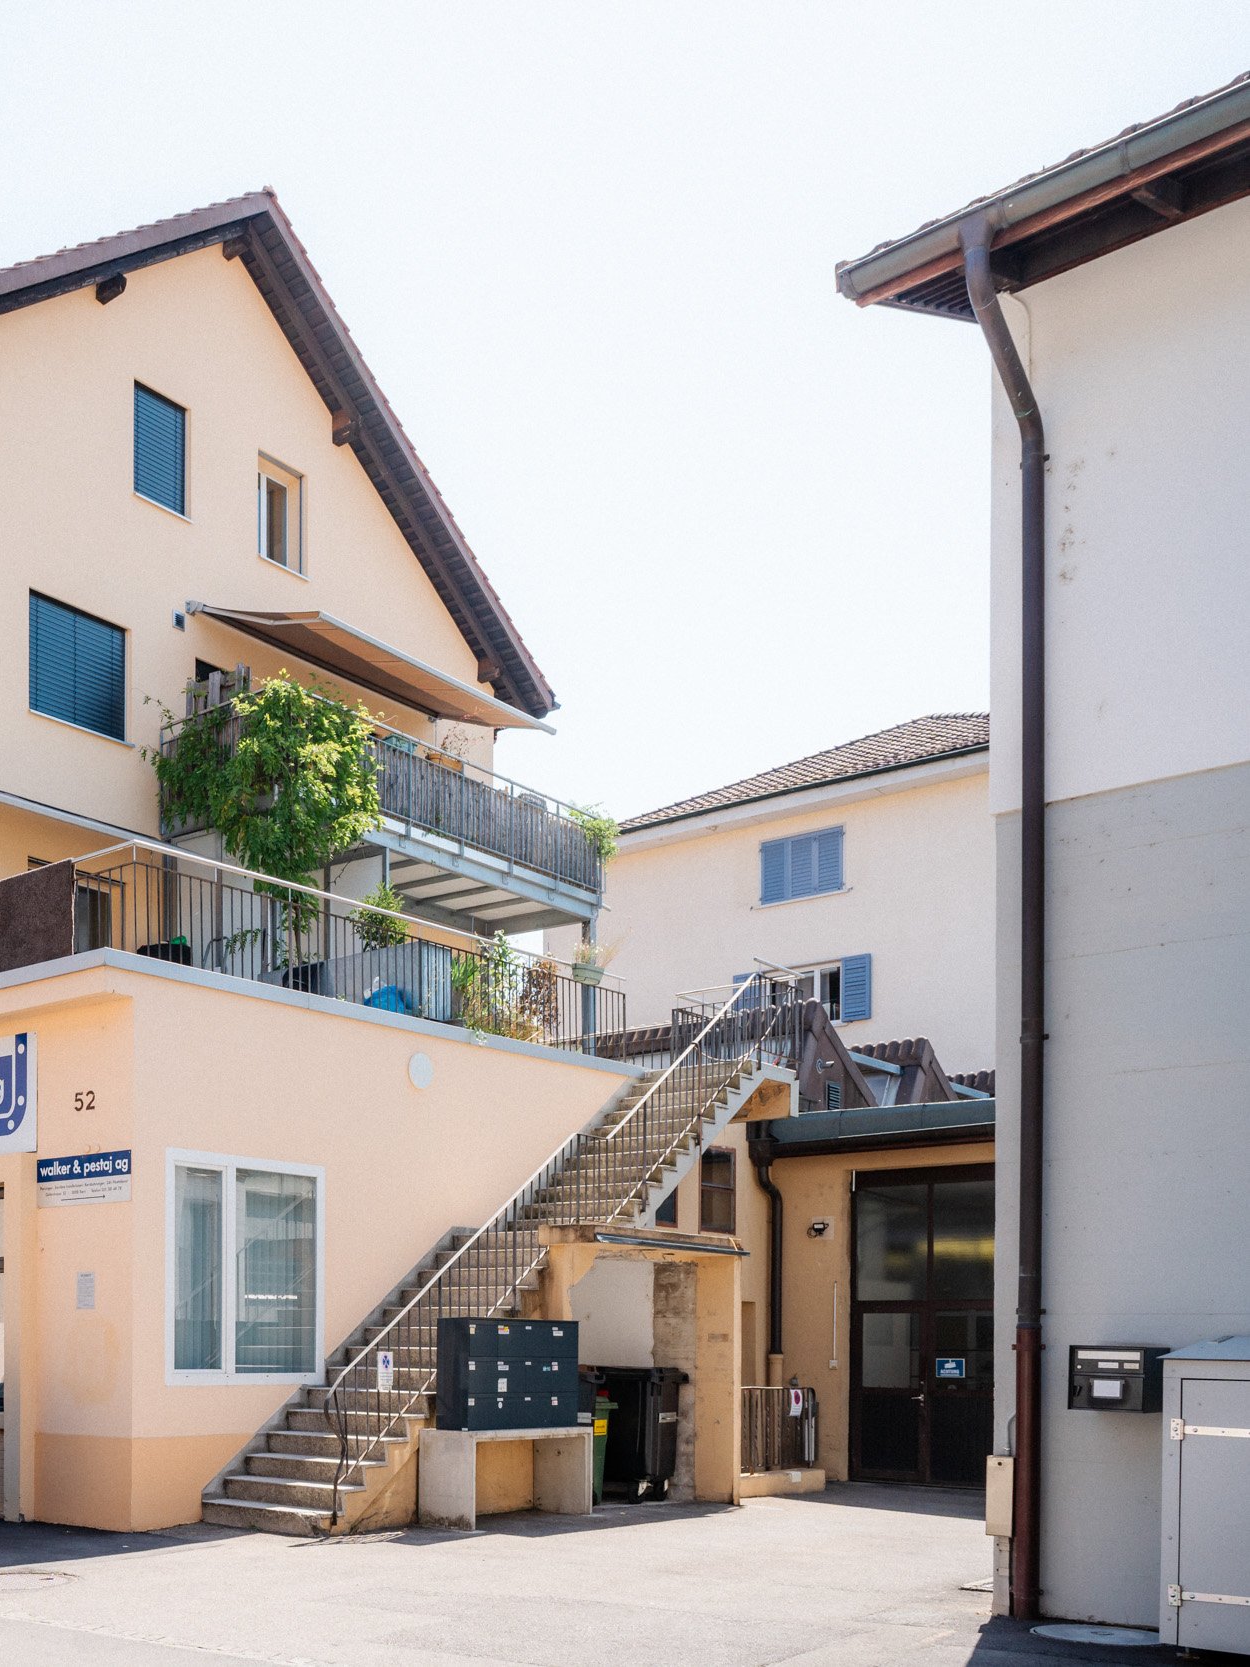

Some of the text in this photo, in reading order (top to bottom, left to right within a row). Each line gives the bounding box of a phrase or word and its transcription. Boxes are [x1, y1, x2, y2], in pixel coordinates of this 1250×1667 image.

[74, 1090, 96, 1112] 52
[39, 1156, 129, 1178] walker & pestaj ag
